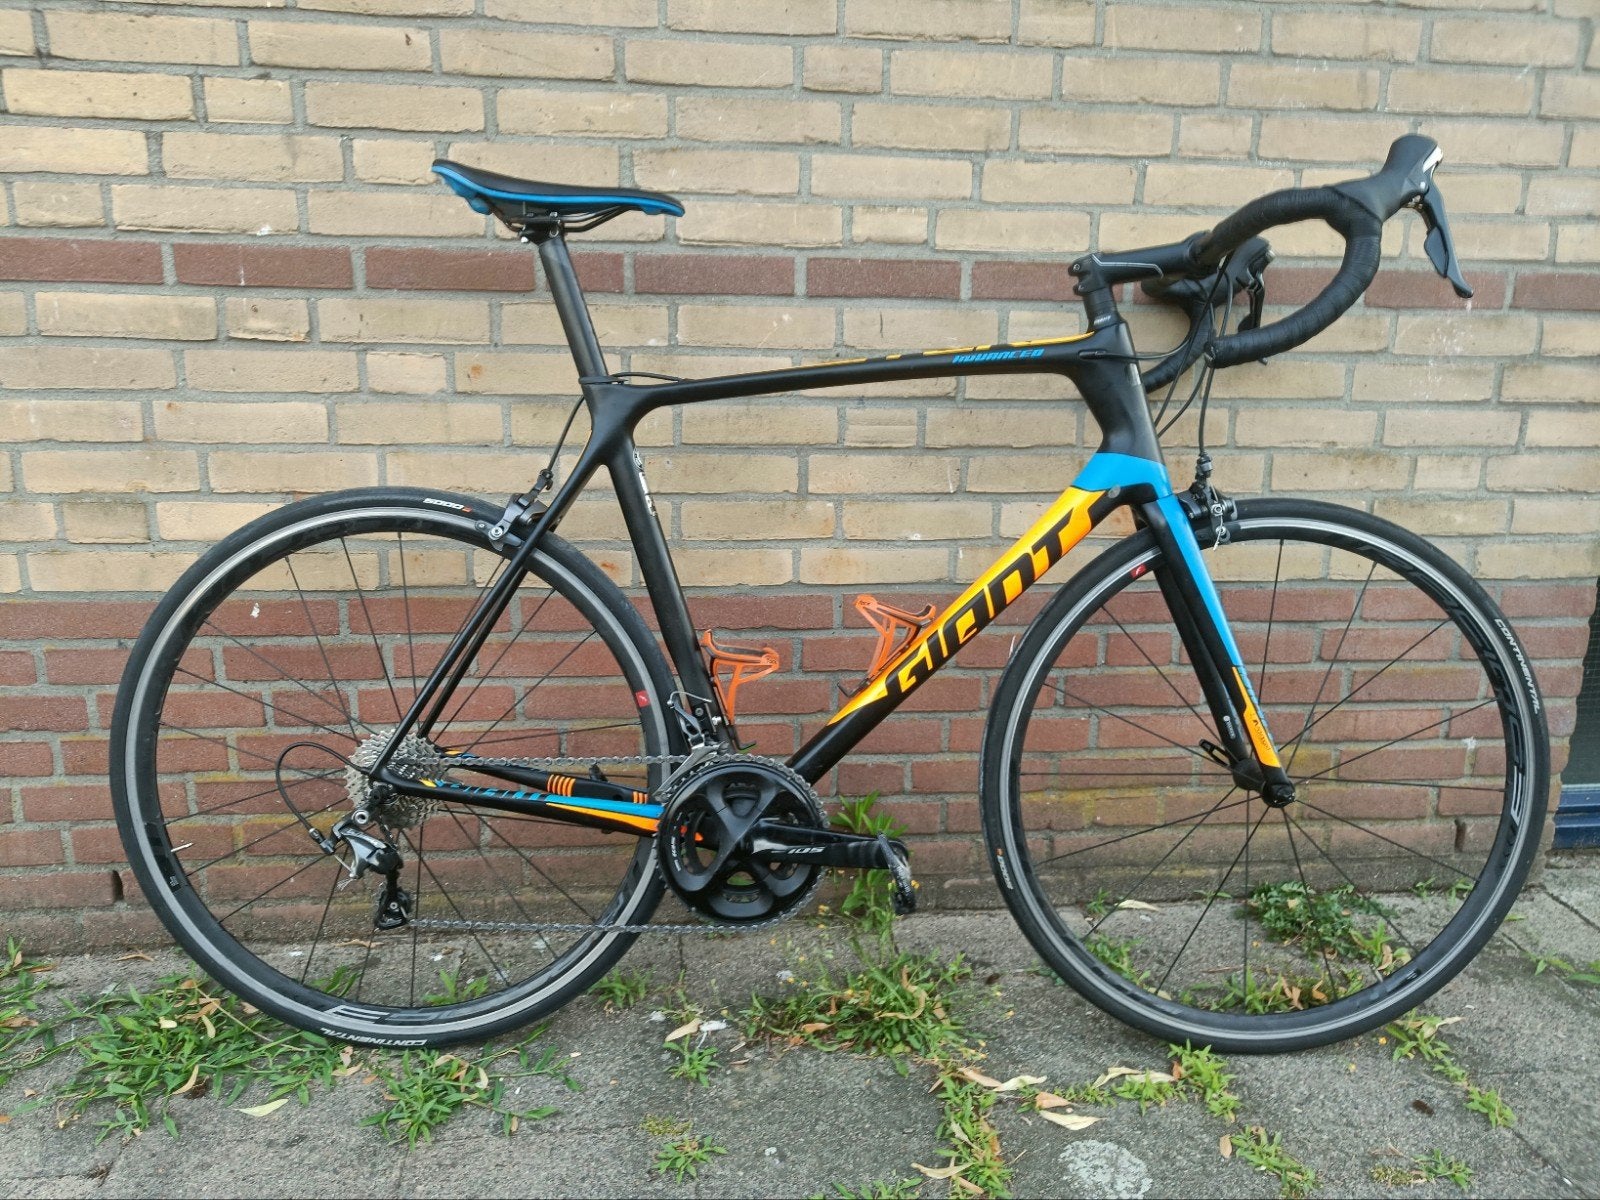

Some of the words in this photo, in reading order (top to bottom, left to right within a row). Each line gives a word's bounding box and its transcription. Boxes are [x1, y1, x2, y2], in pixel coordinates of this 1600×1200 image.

[952, 348, 1045, 364] ADVANCED
[423, 497, 465, 510] 5000
[884, 508, 1074, 697] GIANT
[1495, 618, 1541, 715] CONTINENTAL
[787, 846, 826, 854] 105
[320, 1027, 428, 1046] CONTINENTAL
